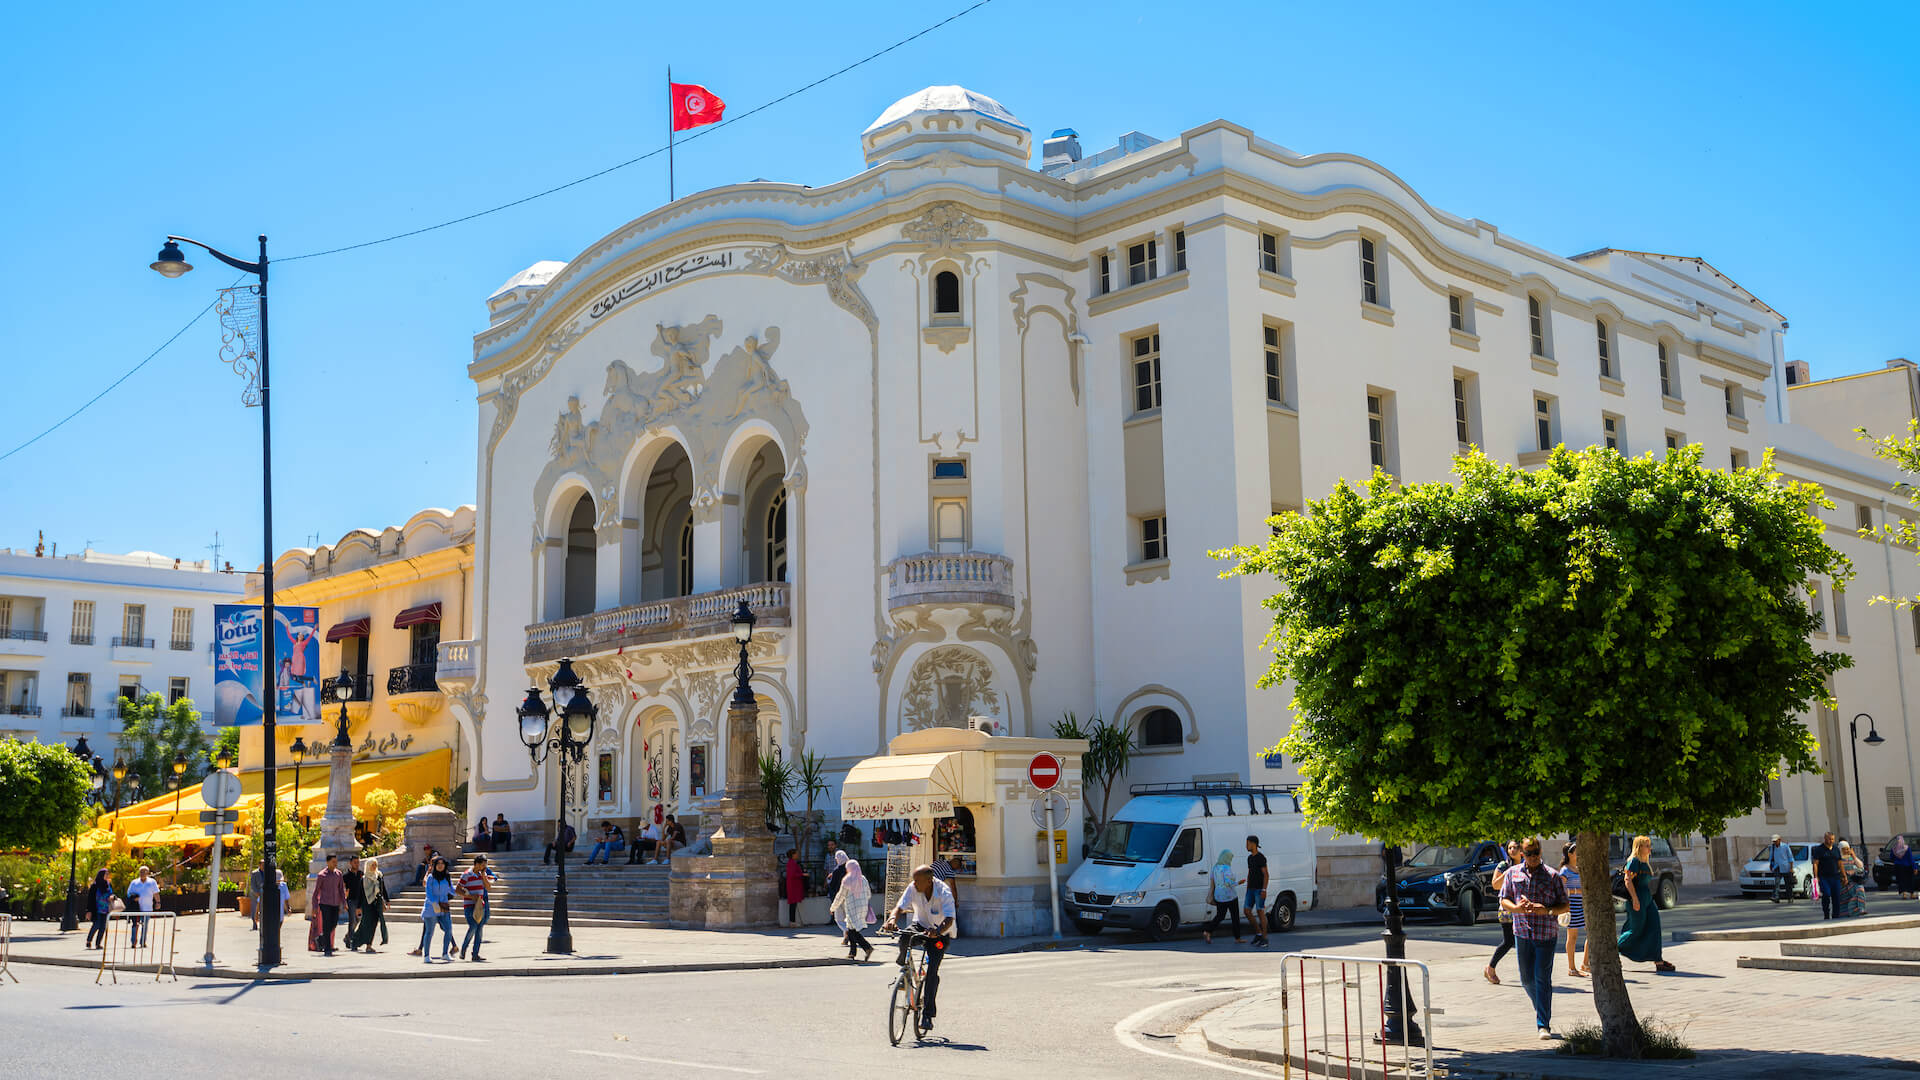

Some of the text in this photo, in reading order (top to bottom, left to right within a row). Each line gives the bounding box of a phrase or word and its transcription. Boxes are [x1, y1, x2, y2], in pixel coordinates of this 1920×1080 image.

[870, 802, 894, 818] طوابع
[899, 801, 921, 815] دخان
[928, 801, 950, 814] TABAC
